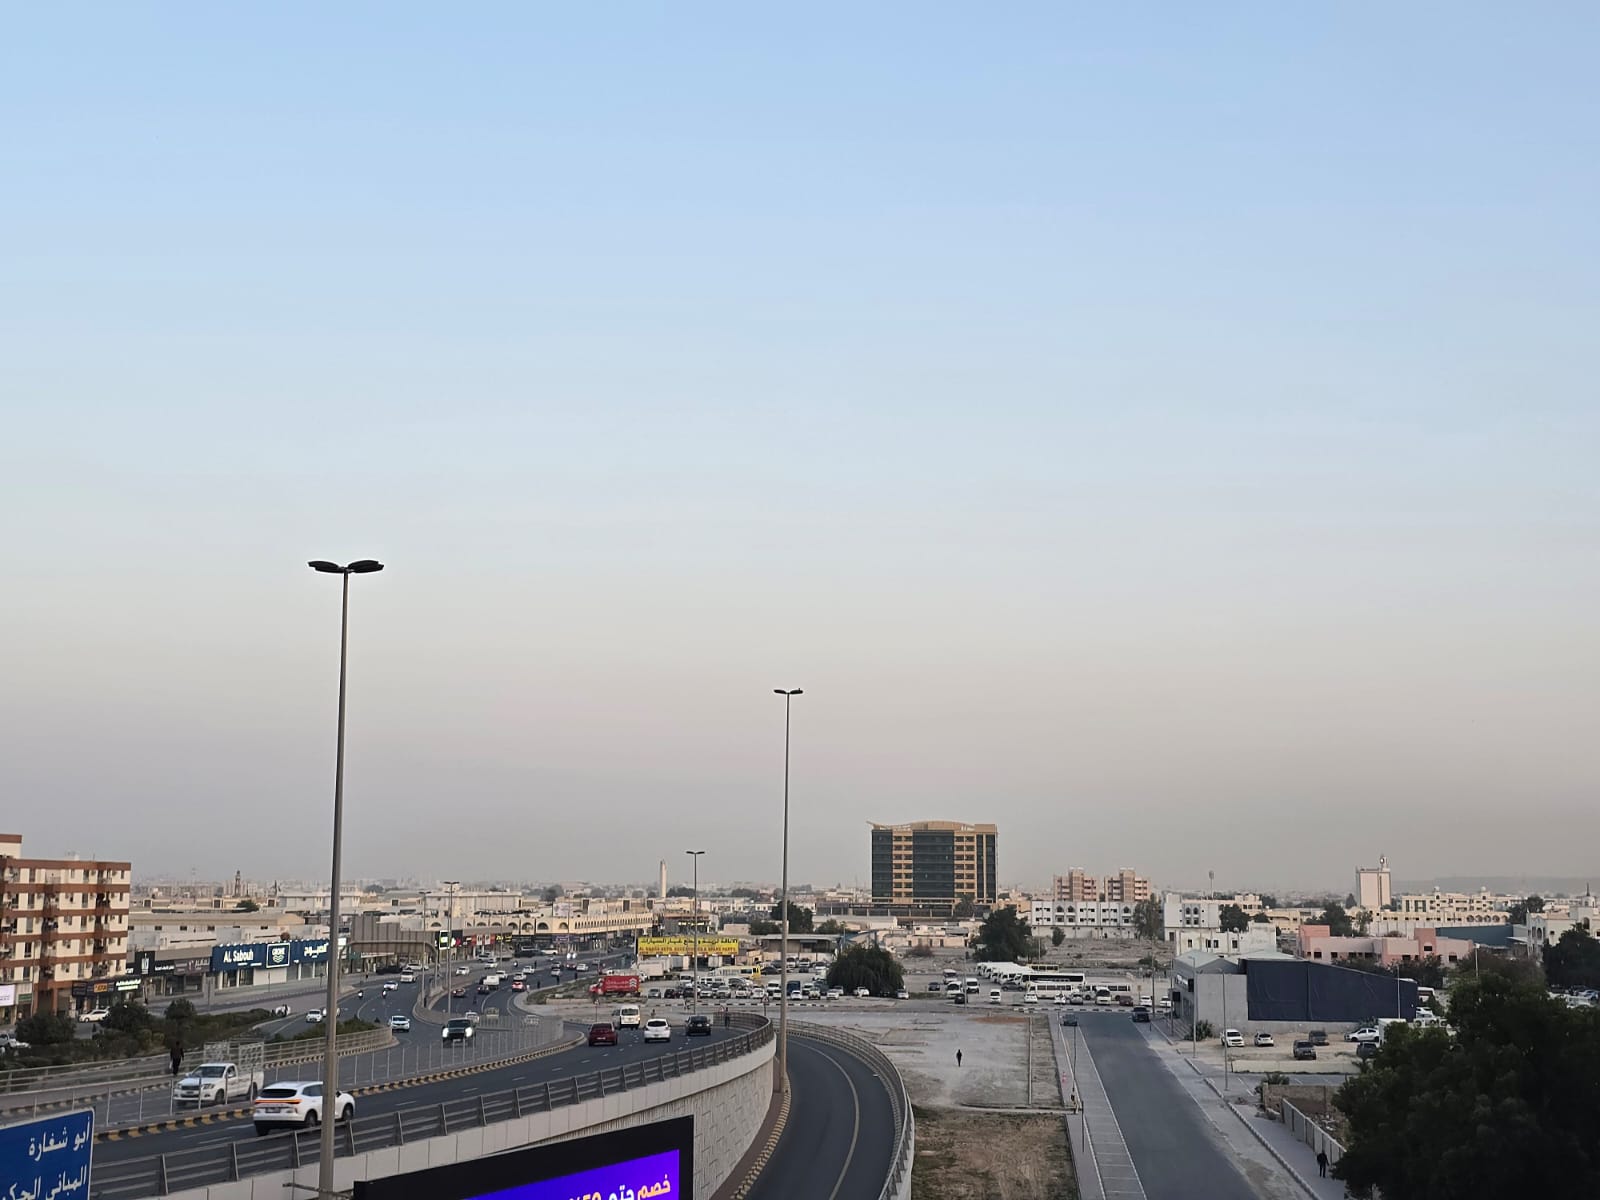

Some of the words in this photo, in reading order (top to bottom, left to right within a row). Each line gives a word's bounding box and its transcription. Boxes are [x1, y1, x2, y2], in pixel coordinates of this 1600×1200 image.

[28, 1127, 68, 1161] شغارة
[73, 1116, 90, 1151] أبو
[1, 1175, 41, 1200] الحك
[637, 1174, 671, 1199] خصم
